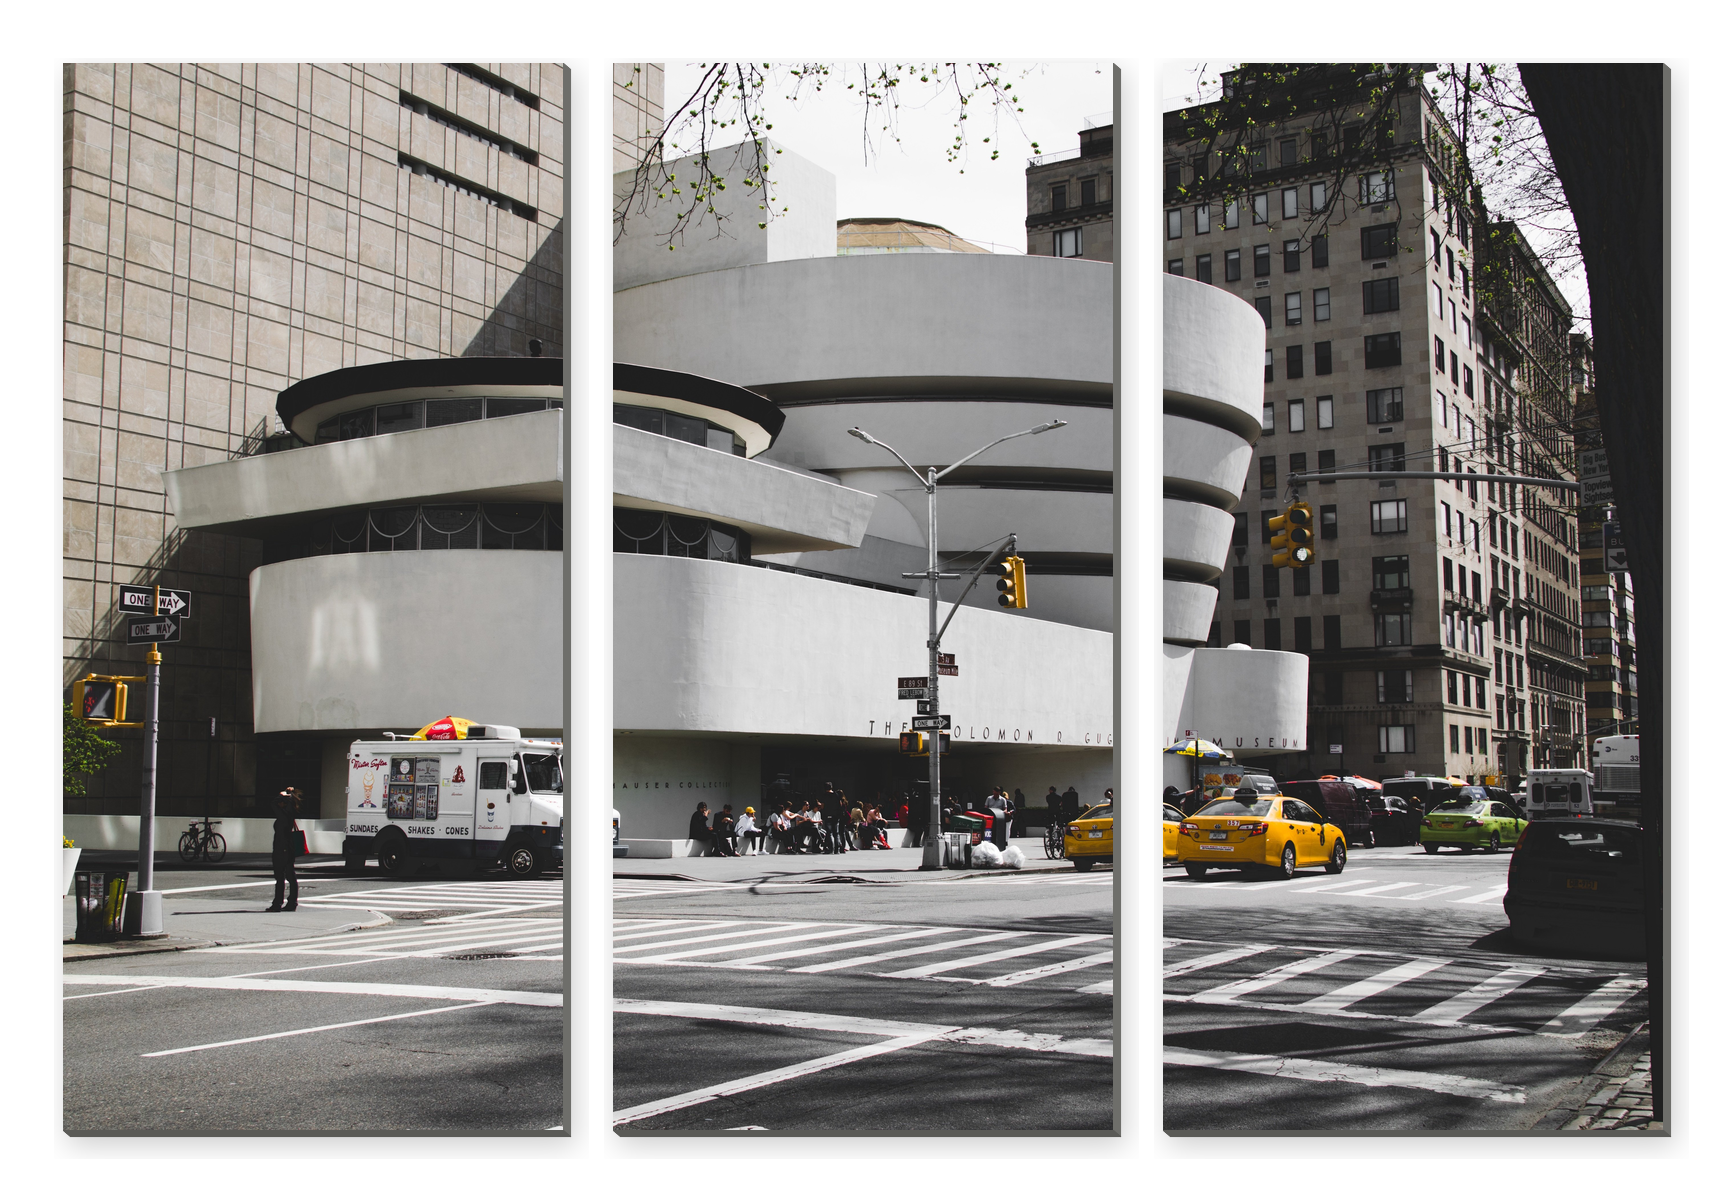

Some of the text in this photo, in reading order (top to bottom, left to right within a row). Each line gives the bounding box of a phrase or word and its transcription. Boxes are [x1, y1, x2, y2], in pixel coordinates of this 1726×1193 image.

[1583, 453, 1607, 465] Big Bus
[1583, 463, 1609, 475] New Yor
[129, 594, 180, 609] ONE WAY
[135, 623, 172, 636] ONE WAY
[903, 680, 907, 688] E
[908, 680, 916, 688] 89
[933, 719, 944, 727] WAY
[954, 725, 1034, 742] OLOMON
[1057, 731, 1062, 743] R
[1212, 737, 1298, 748] MUSEUM
[350, 824, 469, 836] SUNDAES SHAKES CONES
